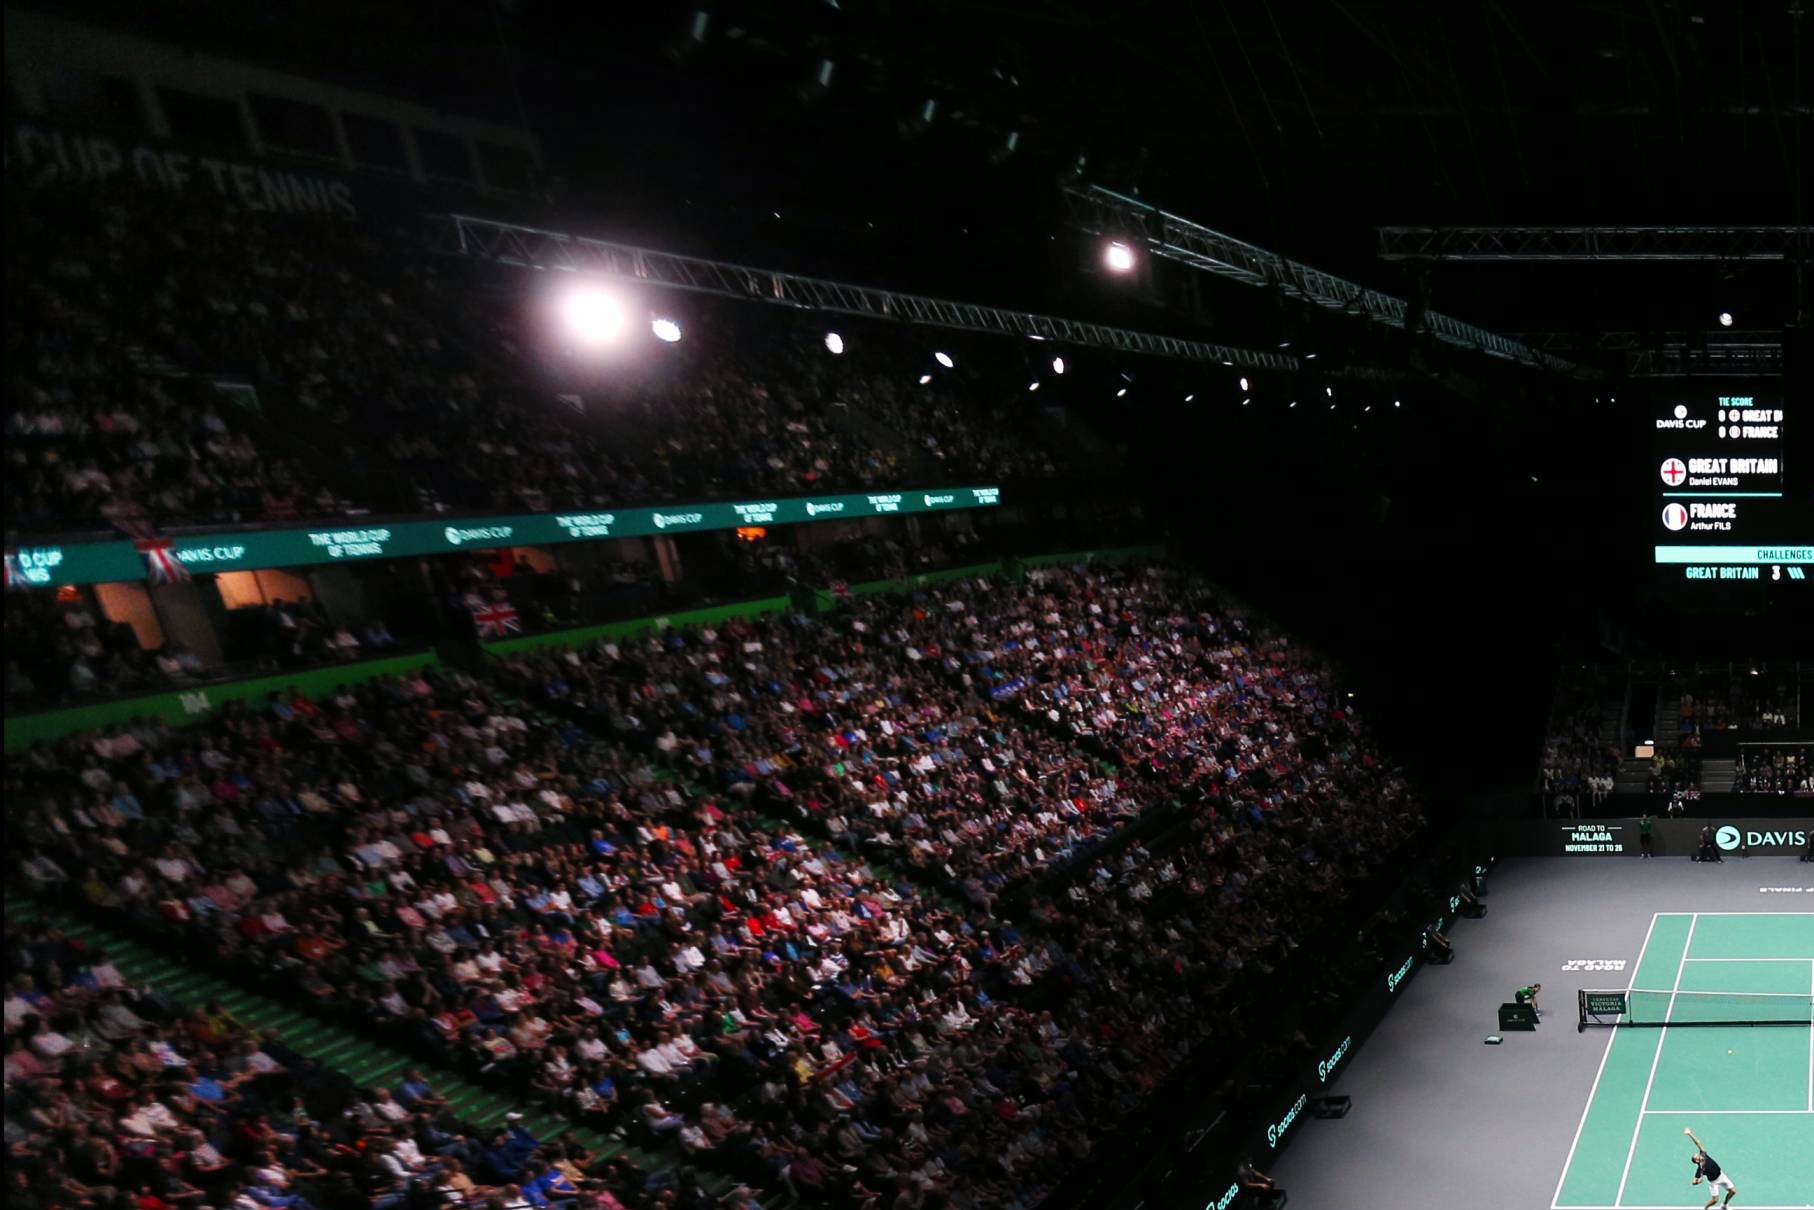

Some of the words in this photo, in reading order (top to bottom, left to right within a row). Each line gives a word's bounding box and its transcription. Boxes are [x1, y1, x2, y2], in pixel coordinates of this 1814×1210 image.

[199, 157, 358, 221] TENNIS
[1742, 409, 1772, 422] GREAT
[1656, 419, 1684, 428] DAVIS
[1685, 419, 1706, 428] CUP
[1742, 426, 1779, 438] FRANCE
[1688, 458, 1728, 473] GREAT
[1730, 458, 1778, 473] BRITAIN
[1689, 477, 1712, 486] Daniel
[1713, 477, 1739, 486] EVANS
[1690, 503, 1737, 518] FRANCE
[1690, 521, 1713, 530] Arthur
[1714, 521, 1732, 530] FILS
[1757, 549, 1813, 561] CHALLENGES
[1686, 567, 1718, 579] GREAT
[1719, 567, 1759, 579] BRITAIN
[1772, 566, 1780, 580] 3
[1746, 832, 1806, 846] DAVIS
[1605, 844, 1614, 852] TO
[1278, 1093, 1308, 1137] socios.com
